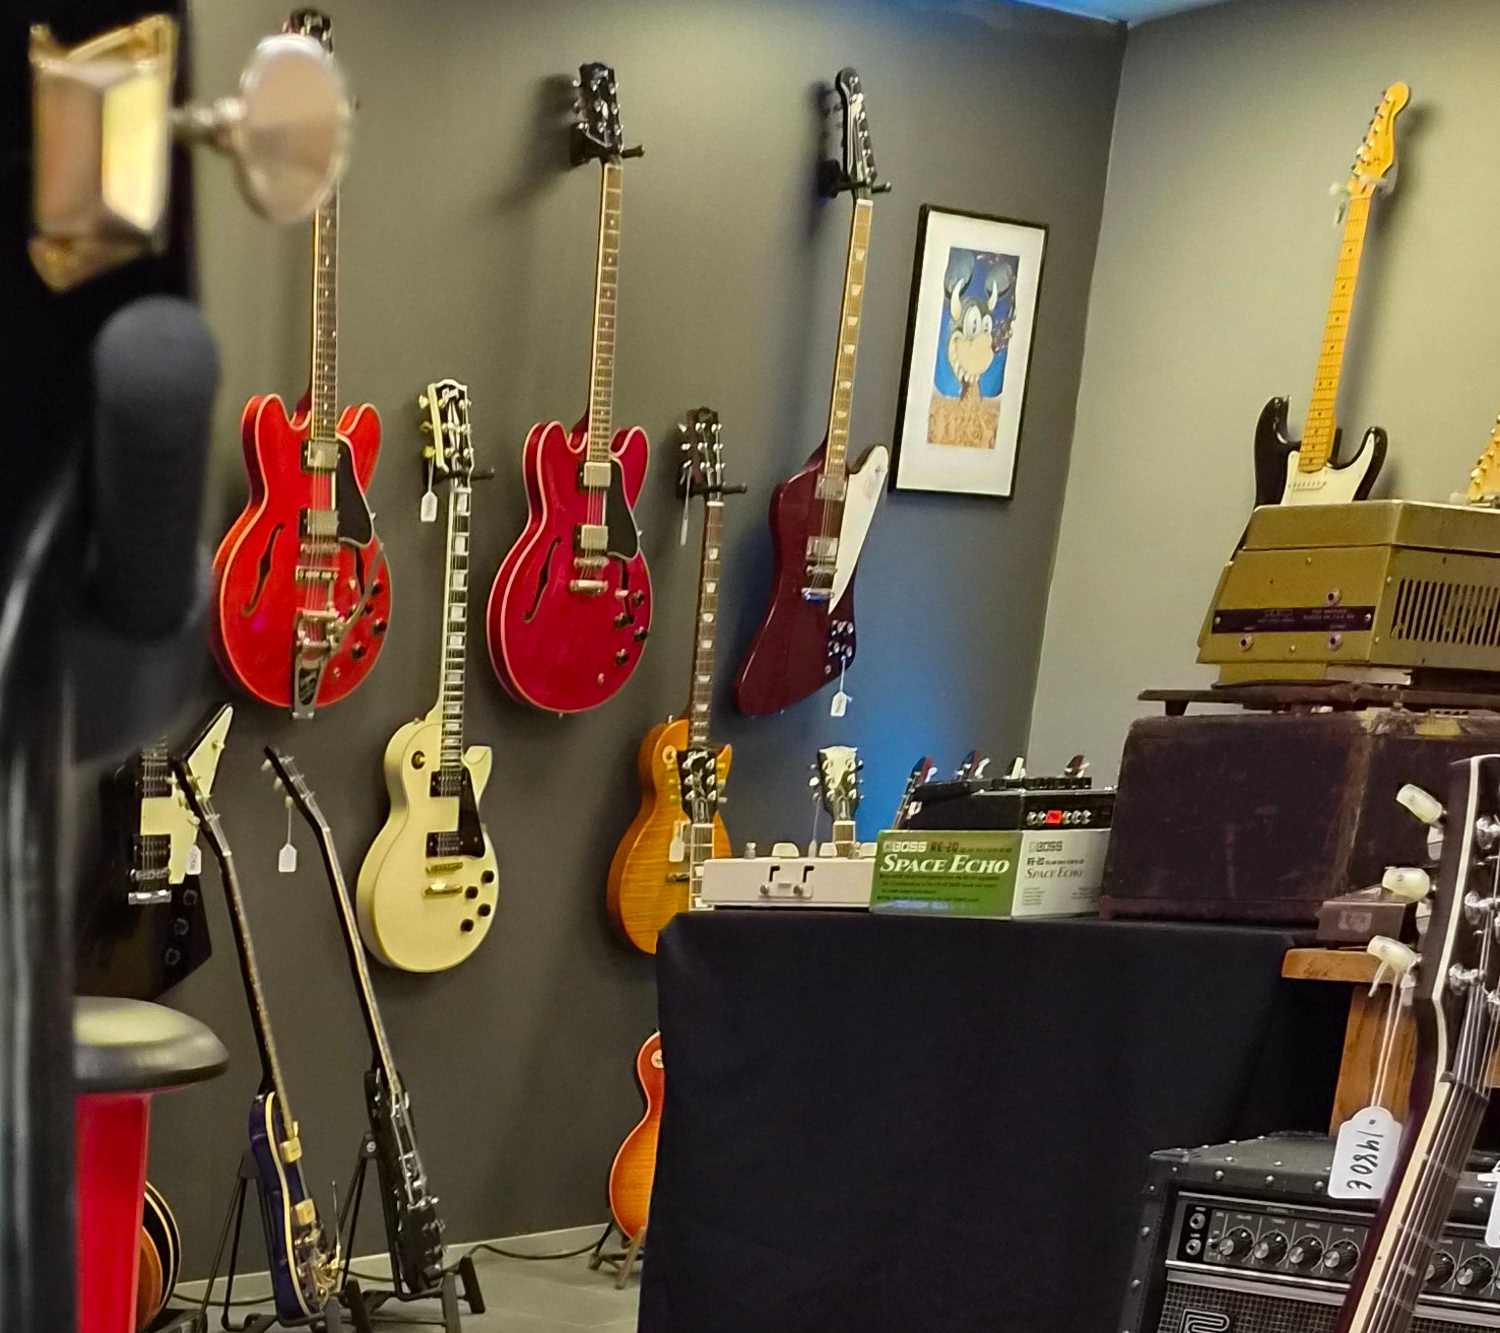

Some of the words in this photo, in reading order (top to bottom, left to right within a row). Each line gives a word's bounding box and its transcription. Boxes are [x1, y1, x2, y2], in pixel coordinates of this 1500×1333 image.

[892, 840, 927, 853] BOSS
[880, 853, 948, 873] SPACE
[948, 854, 1010, 874] ECHO
